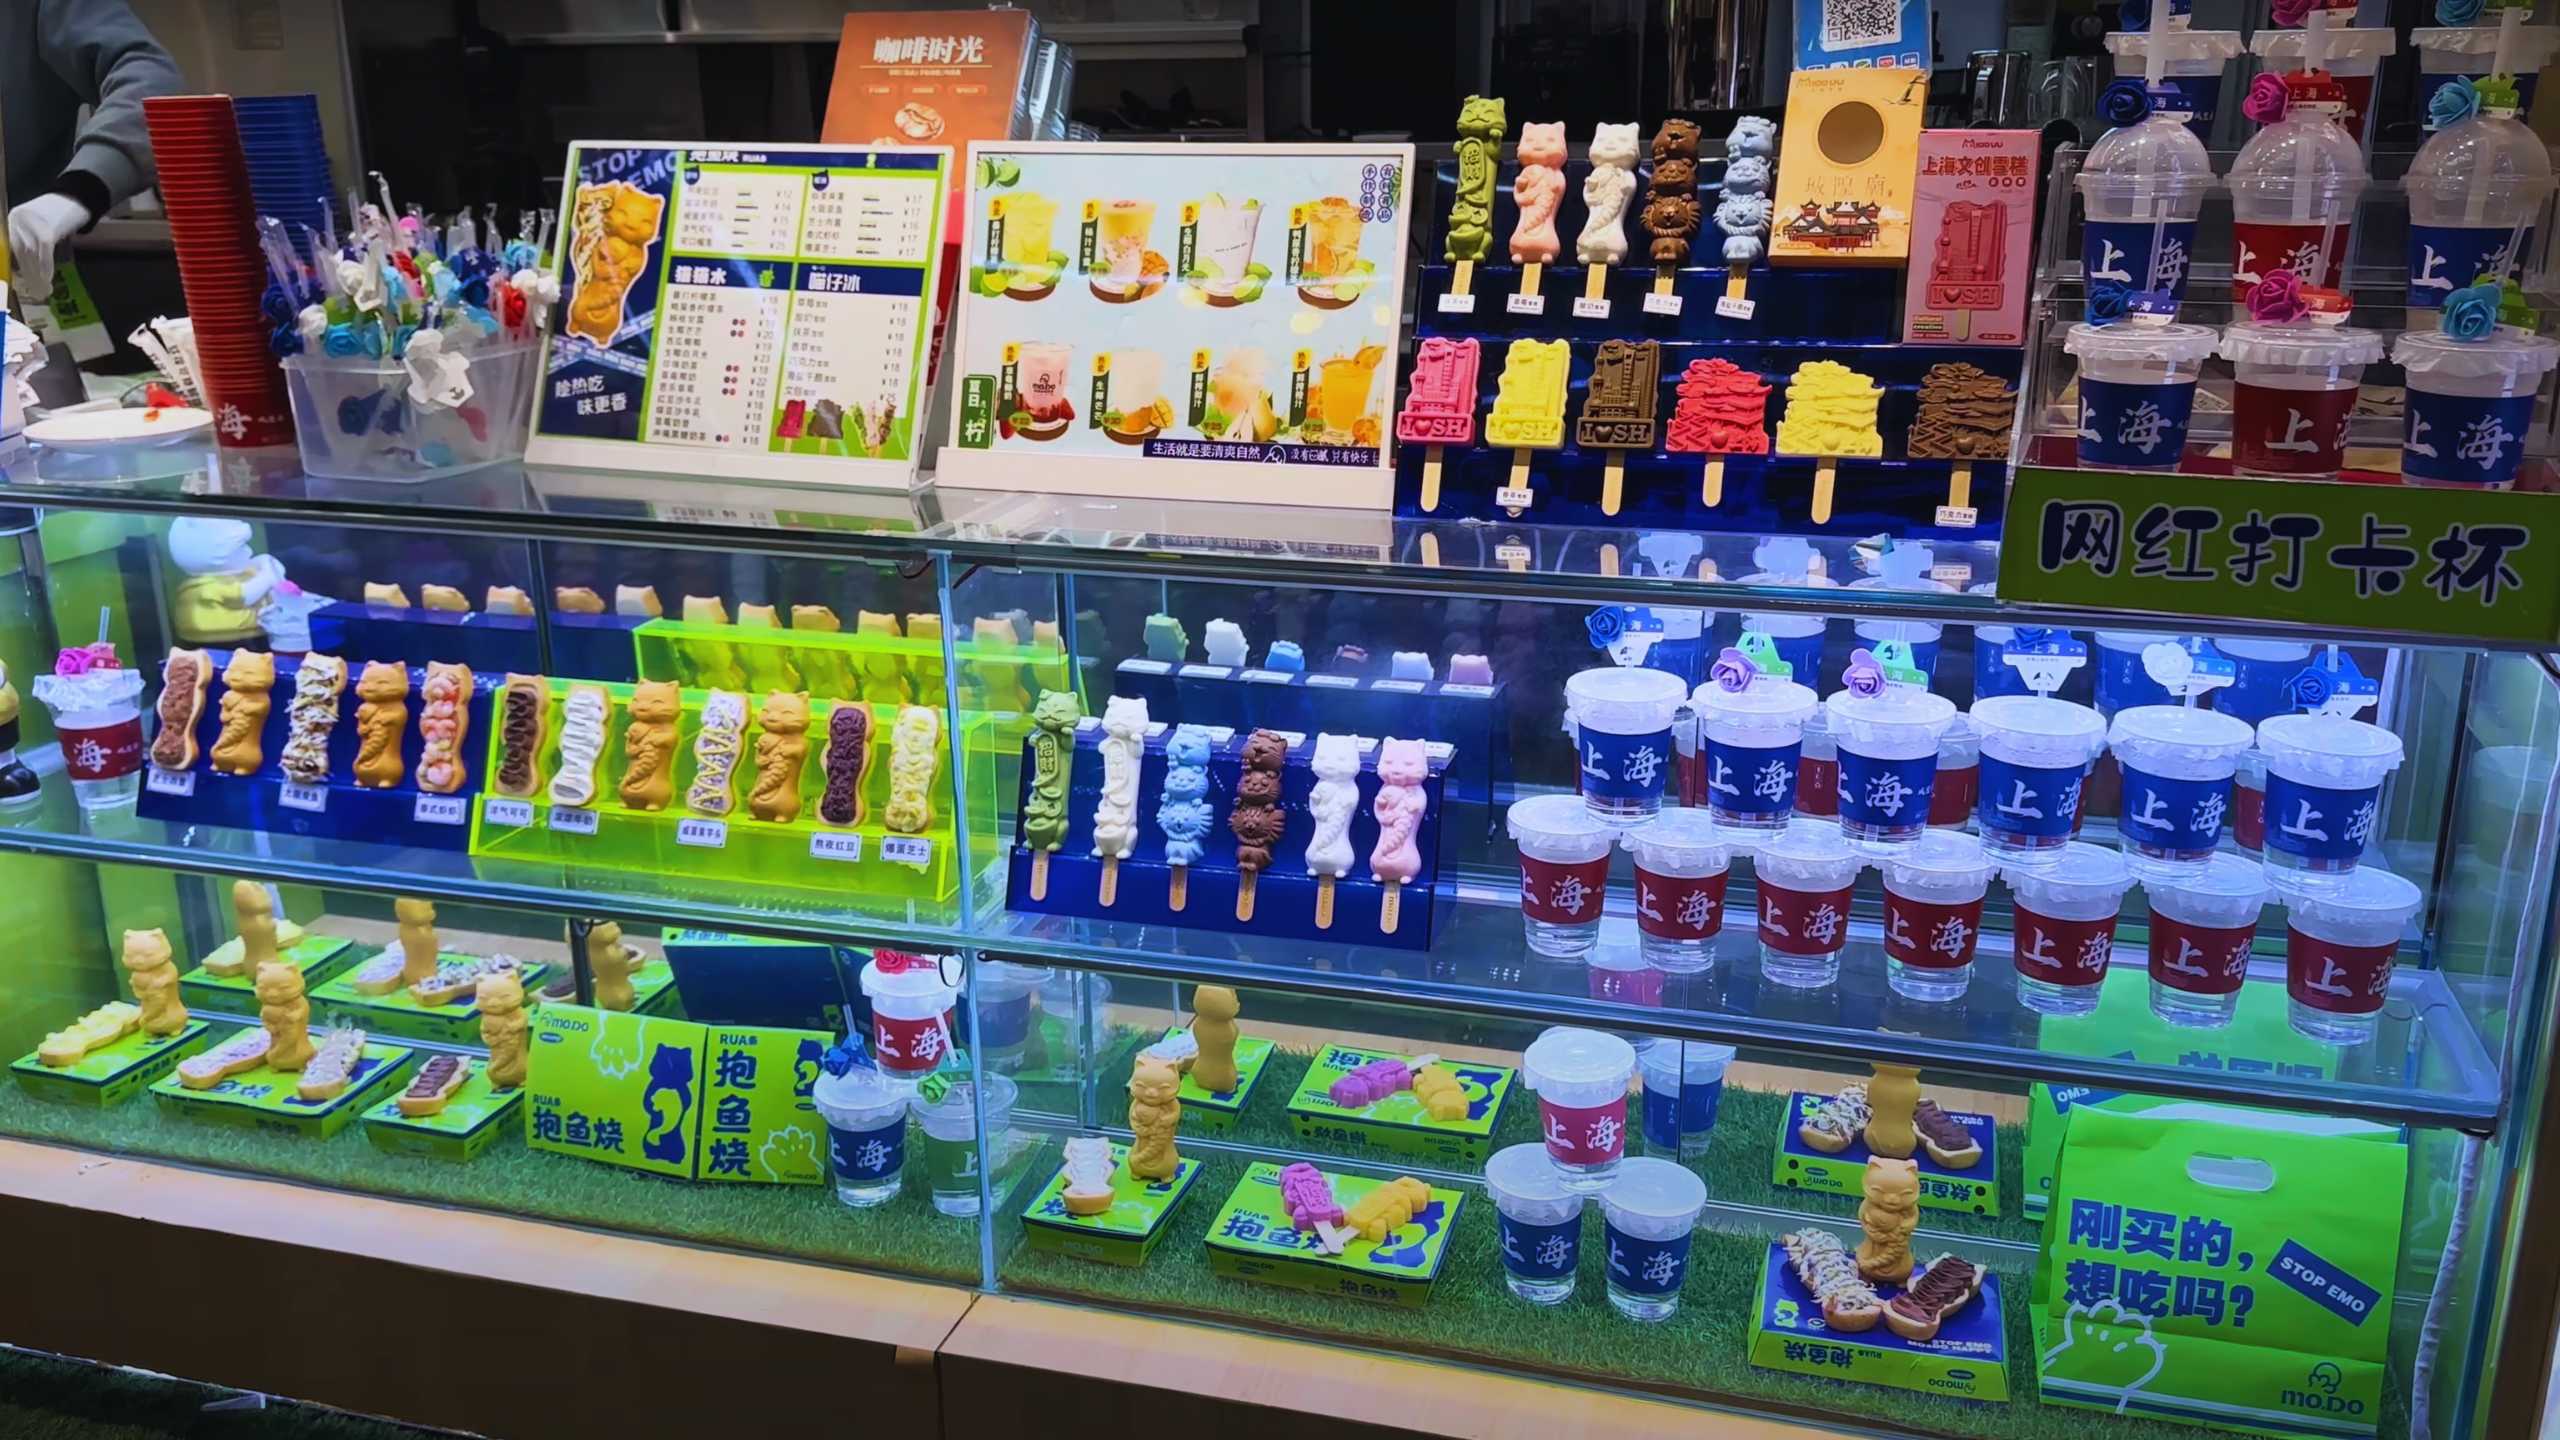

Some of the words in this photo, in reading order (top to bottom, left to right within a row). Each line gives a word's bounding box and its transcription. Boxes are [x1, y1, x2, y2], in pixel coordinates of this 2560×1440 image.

[873, 35, 984, 64] 咖啡时光
[1922, 155, 2029, 176] 上海文创雪糕
[2089, 237, 2188, 287] 上海
[217, 402, 252, 441] 海
[577, 393, 628, 415] 味更香
[1432, 419, 1466, 435] SH
[2078, 395, 2173, 454] 上海
[1152, 442, 1261, 460] 生活就是要清爽自然
[1615, 425, 1647, 442] SH
[2403, 410, 2514, 470] 上海
[2038, 499, 2529, 605] 网红打卡杯
[73, 737, 113, 773] 海
[1581, 741, 1663, 787] 上海
[1708, 756, 1793, 804] 上海
[1997, 776, 2083, 820] 上海
[2131, 788, 2227, 837] 上海
[2280, 799, 2374, 844] 上海
[1521, 864, 1591, 916] 上海
[1637, 880, 1717, 932] 上海
[1760, 896, 1843, 945] 上海
[1887, 906, 1971, 959] 上海
[2021, 927, 2111, 973] 上海
[2163, 935, 2250, 980] 上海
[2304, 956, 2394, 999] 上海
[875, 1024, 946, 1061] 上海
[533, 1106, 624, 1154] 抱鱼烧
[708, 1050, 757, 1177] 抱鱼烧
[1545, 1113, 1622, 1153] 上海
[1502, 1225, 1573, 1270] 上海
[2067, 1198, 2255, 1272] 刚买的，
[1609, 1238, 1680, 1287] 上海
[2279, 1255, 2328, 1290] STOP
[2326, 1281, 2367, 1314] EMO
[2064, 1258, 2255, 1328] 想吃吗？
